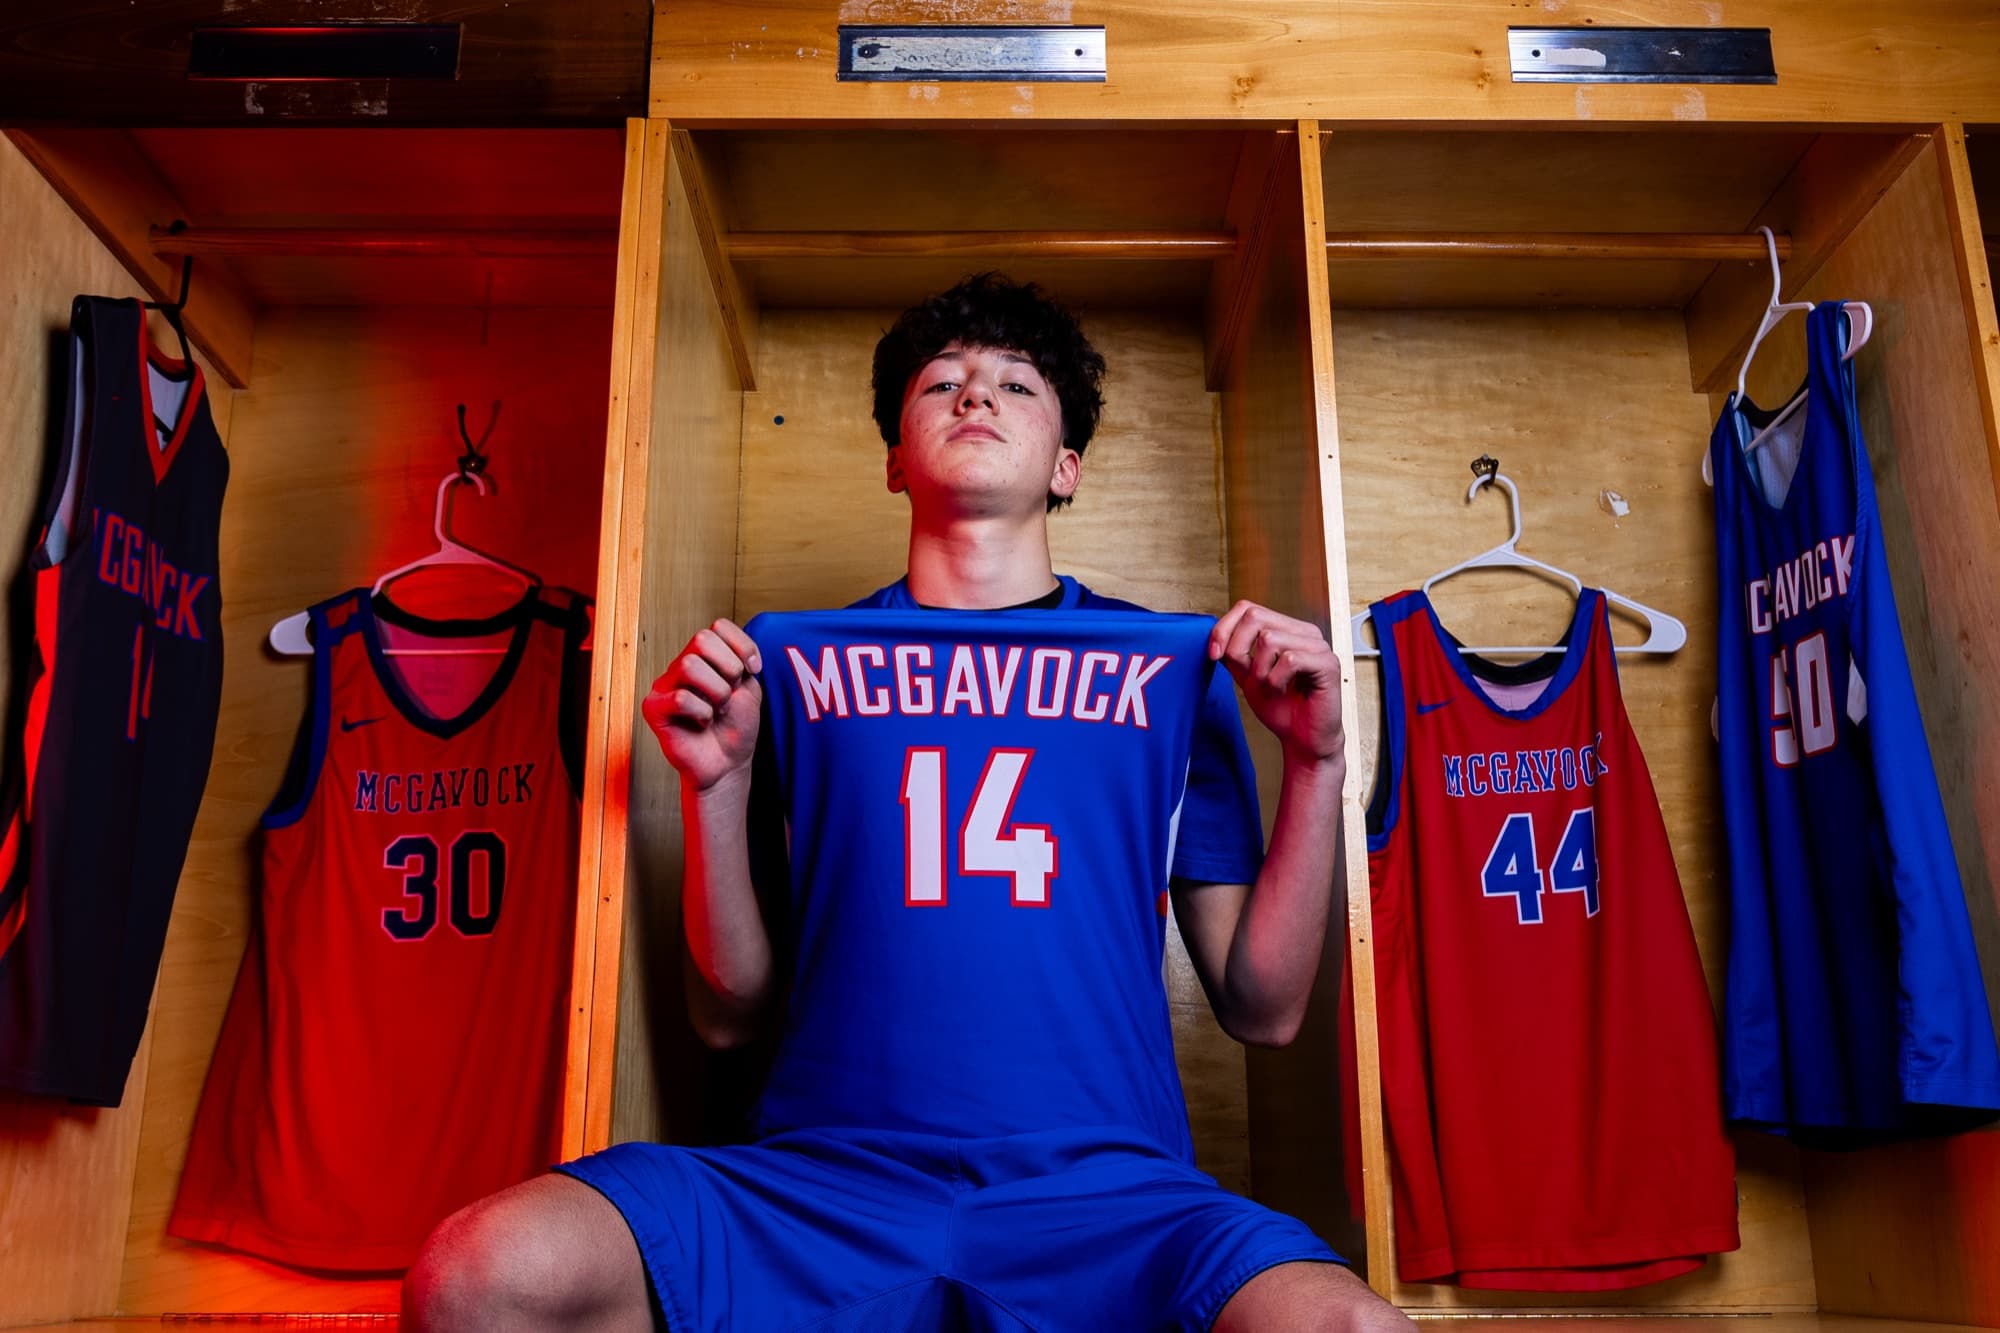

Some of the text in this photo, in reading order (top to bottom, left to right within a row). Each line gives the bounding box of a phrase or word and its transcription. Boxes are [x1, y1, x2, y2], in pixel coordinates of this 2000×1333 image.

[784, 644, 1174, 729] MCGAVOCK
[354, 763, 536, 815] MCGAVOCK
[899, 746, 1058, 907] 14
[381, 829, 507, 942] 30
[1480, 806, 1600, 925] 44
